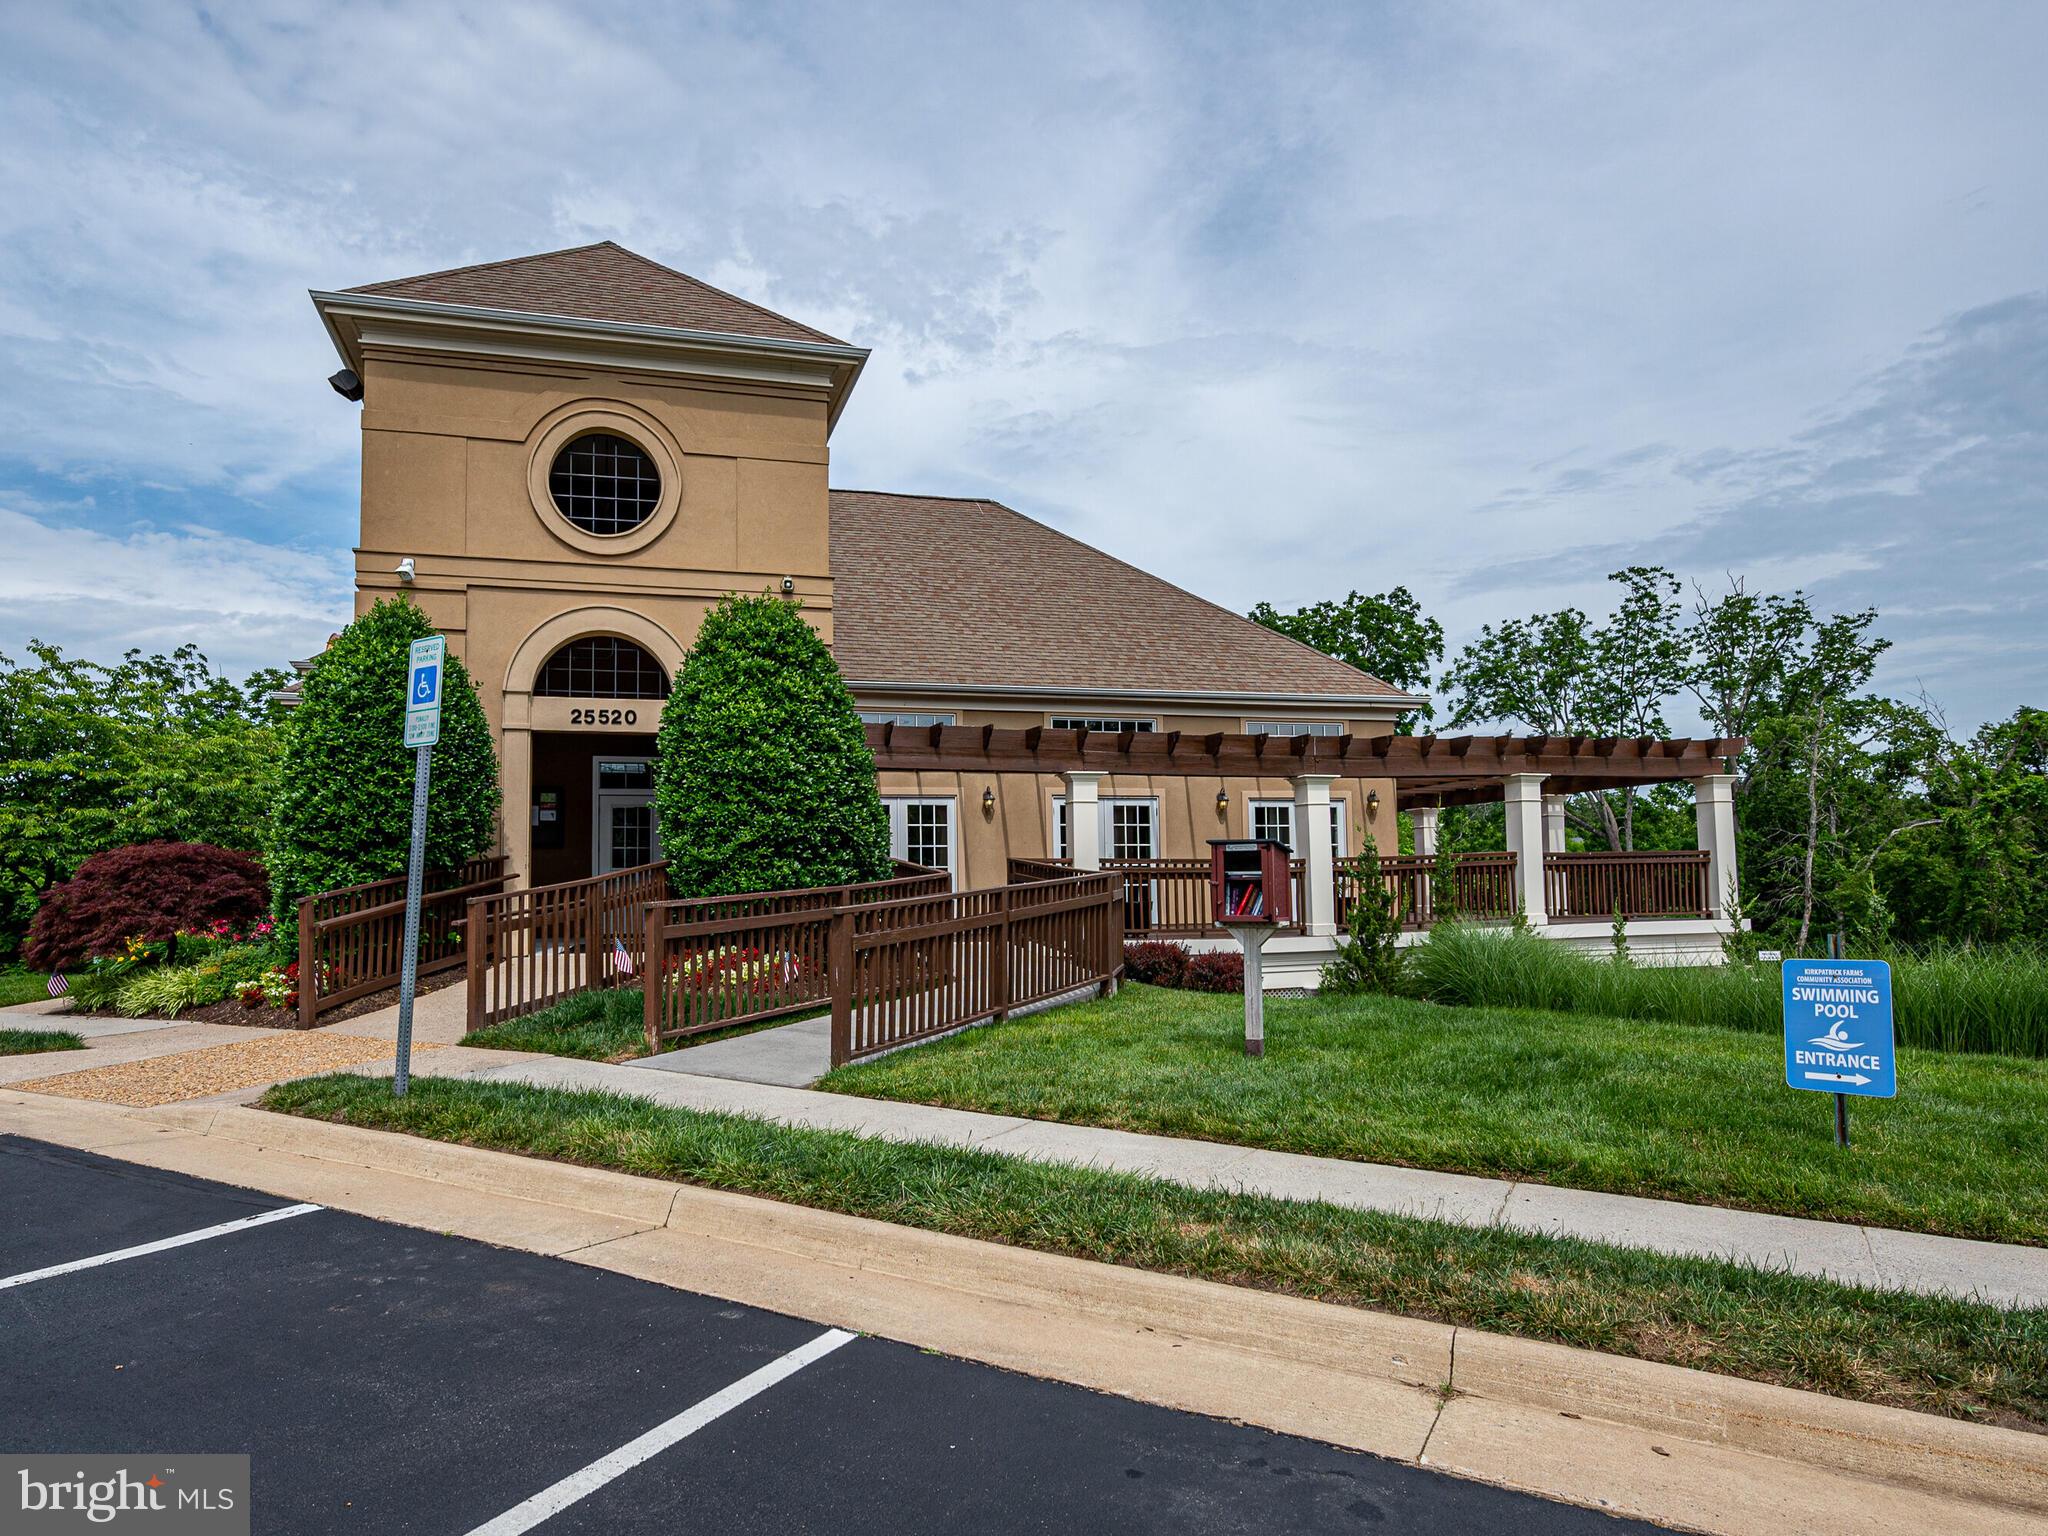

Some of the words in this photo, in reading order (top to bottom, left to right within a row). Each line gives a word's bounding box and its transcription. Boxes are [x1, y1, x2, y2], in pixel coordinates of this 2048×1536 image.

[415, 643, 440, 653] RESERVED
[416, 654, 437, 663] PARKING
[570, 708, 637, 725] 25520
[1804, 968, 1842, 976] KIRKPATRICK
[1842, 969, 1864, 977] FARMS
[1796, 975, 1832, 984] COMMUNITY
[1833, 976, 1872, 985] ASSOCIATION
[1791, 987, 1879, 1004] SWIMMING
[1814, 1003, 1859, 1019] POOL
[1795, 1050, 1880, 1070] ENTRANCE
